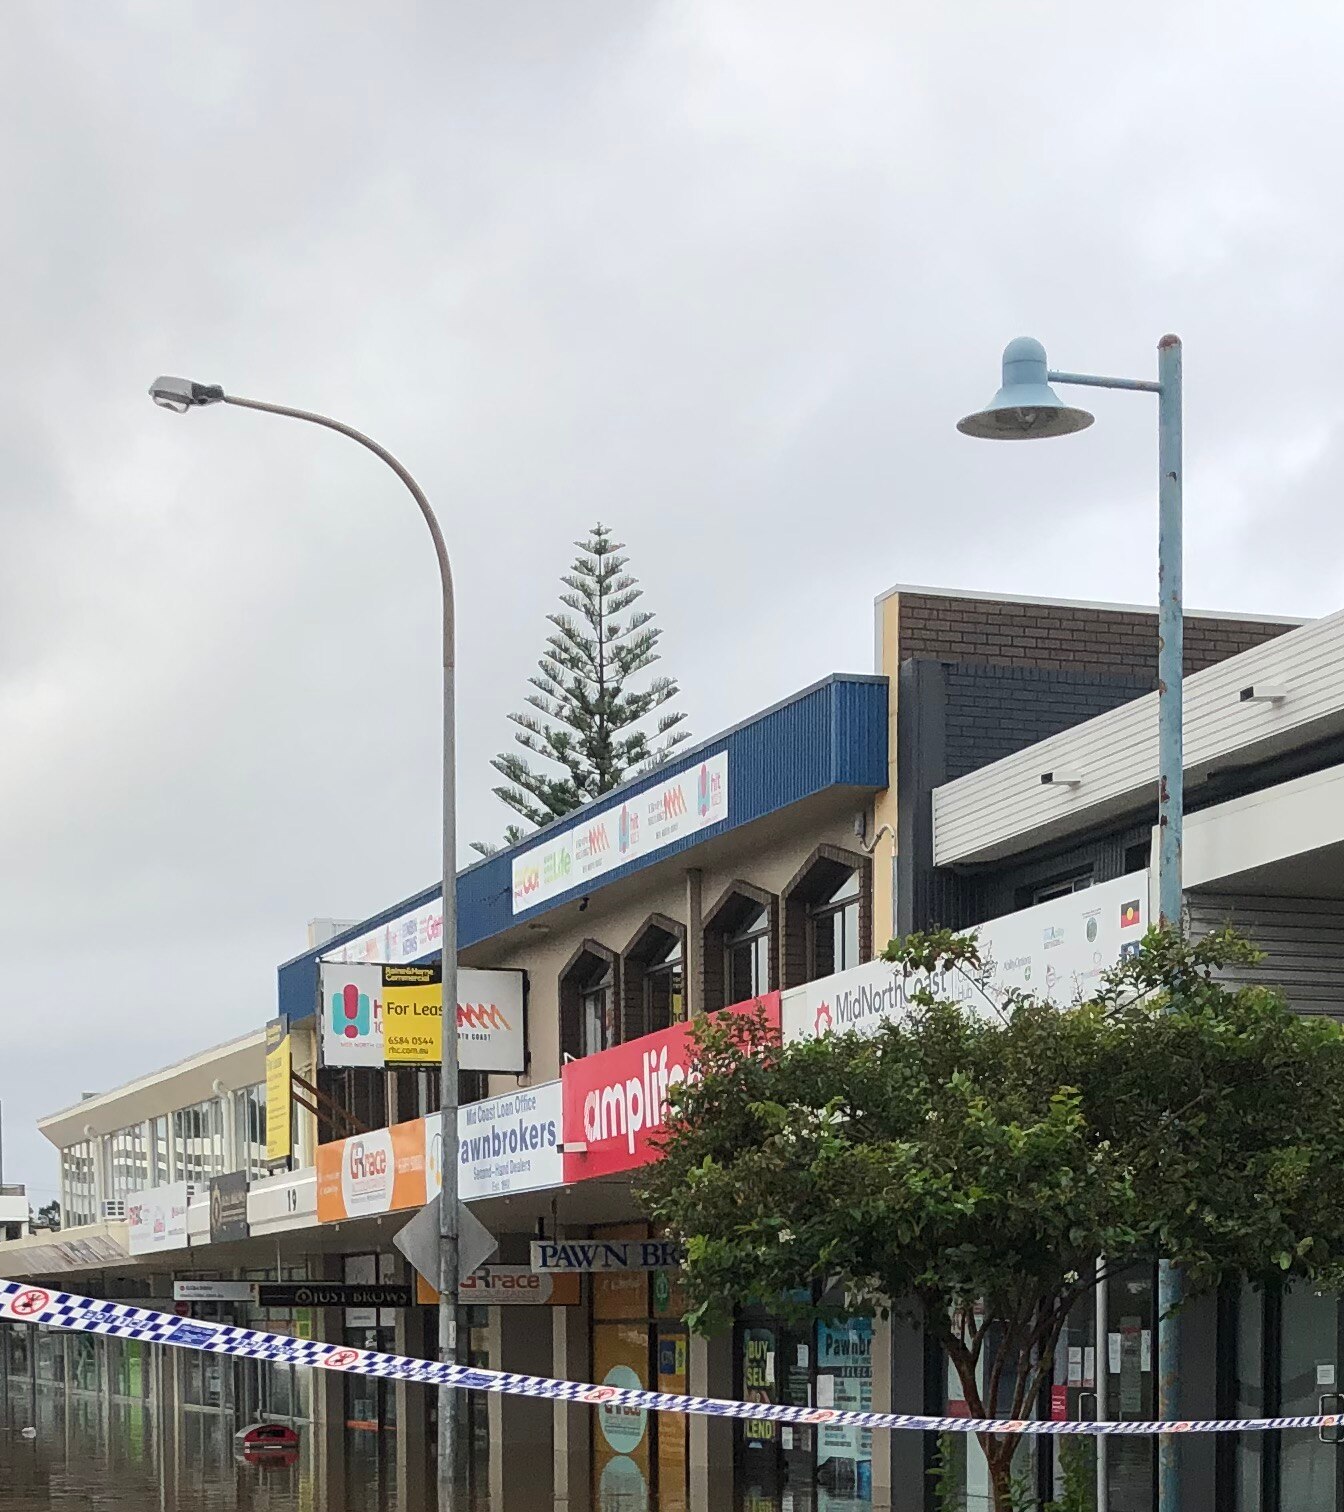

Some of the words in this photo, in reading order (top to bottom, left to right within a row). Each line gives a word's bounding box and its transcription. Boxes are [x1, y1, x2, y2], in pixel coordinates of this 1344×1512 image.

[387, 1002, 409, 1016] For
[413, 1002, 443, 1016] Leas
[478, 1104, 496, 1123] Coast
[497, 1101, 514, 1118] Loan
[515, 1094, 536, 1114] Office
[457, 1118, 557, 1164] awnbrokers
[287, 1188, 297, 1212] 19
[539, 1243, 630, 1268] PAWN
[748, 1340, 769, 1360] BUY
[826, 1332, 872, 1356] Pawnbr
[746, 1420, 773, 1439] LEND
